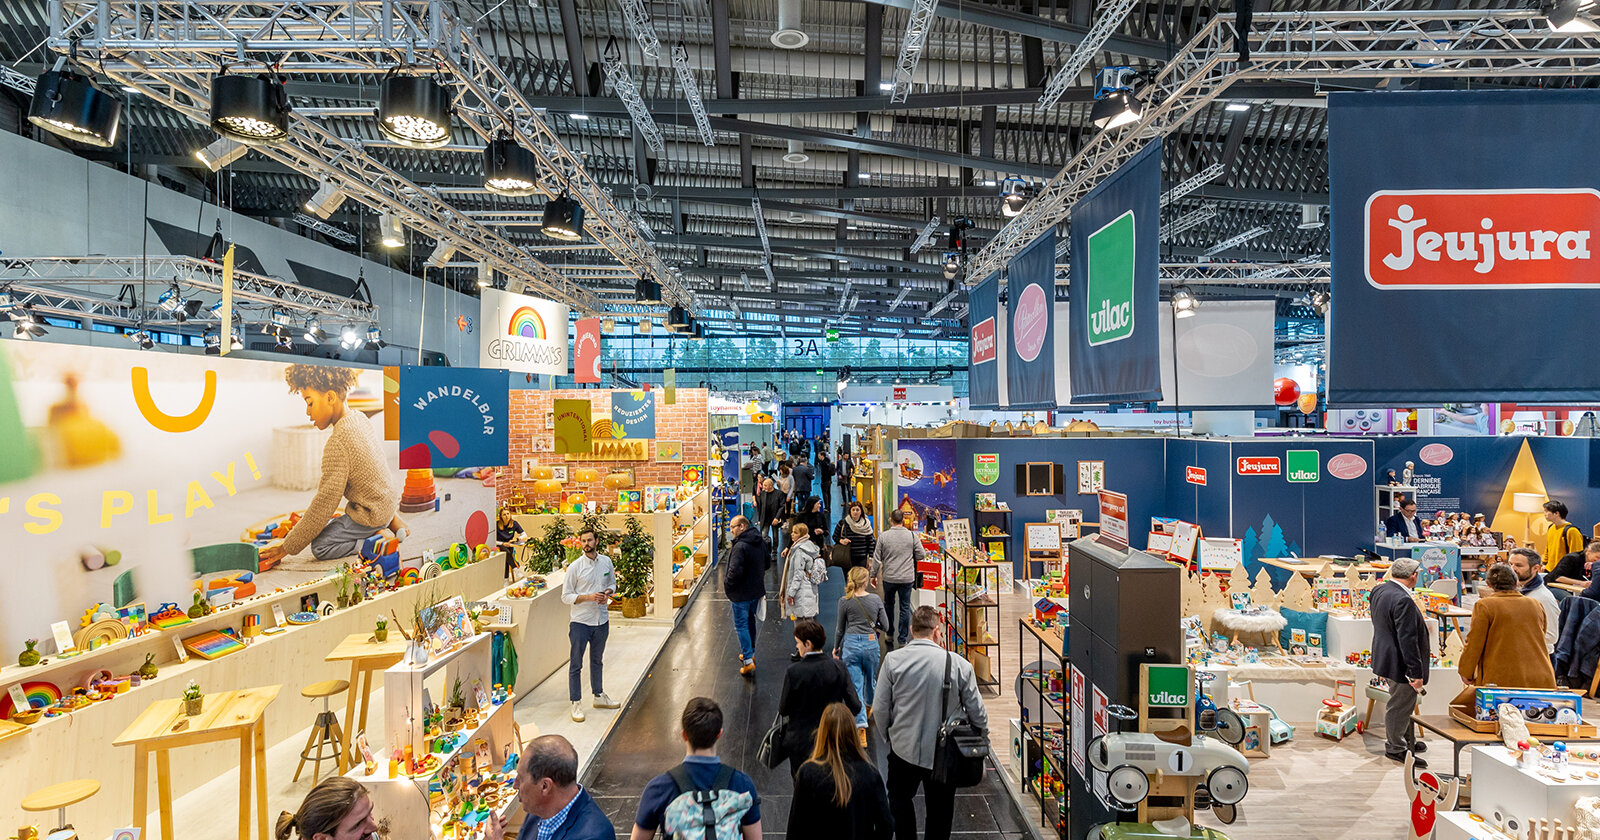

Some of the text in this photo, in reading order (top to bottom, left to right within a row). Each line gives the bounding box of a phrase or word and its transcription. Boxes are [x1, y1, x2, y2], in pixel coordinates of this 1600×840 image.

[1090, 299, 1130, 336] vilac
[487, 338, 563, 366] GRIMM'S
[793, 339, 819, 356] 3A
[413, 385, 495, 436] WANDELBAR
[613, 399, 652, 417] REDUZIERTES
[557, 411, 588, 443] UNINTENTIONAL
[625, 413, 648, 425] DESIGN
[1290, 470, 1317, 480] vilac
[100, 451, 262, 529] PLAY!
[1150, 690, 1186, 704] vilac
[1175, 751, 1184, 771] 1
